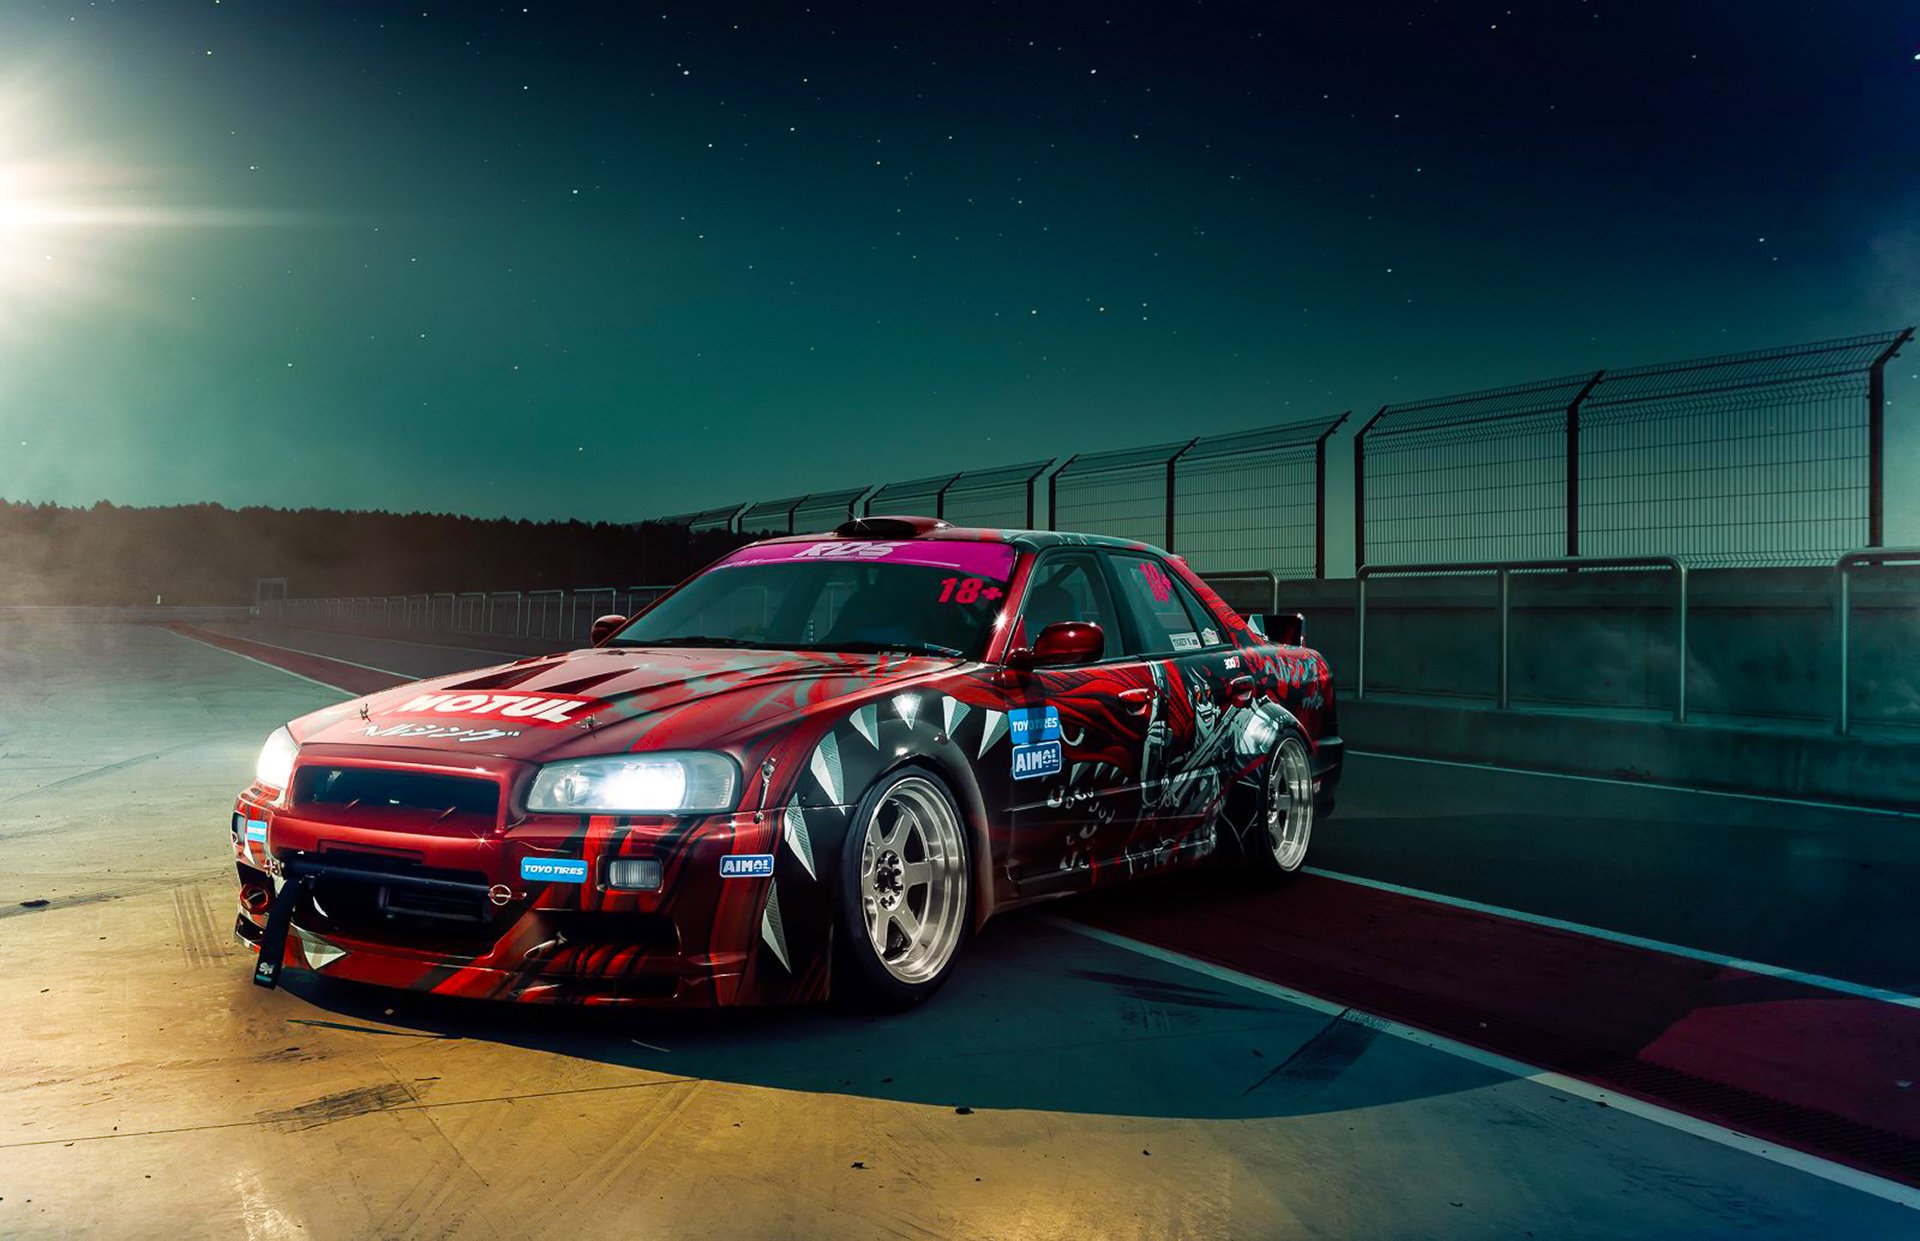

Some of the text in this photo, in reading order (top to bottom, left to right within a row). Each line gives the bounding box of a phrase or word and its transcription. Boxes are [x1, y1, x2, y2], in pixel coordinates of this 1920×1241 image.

[938, 577, 1004, 604] 18+
[381, 694, 587, 723] MOTUL
[524, 864, 585, 875] TOYO TIRES
[722, 859, 771, 873] AIMOL
